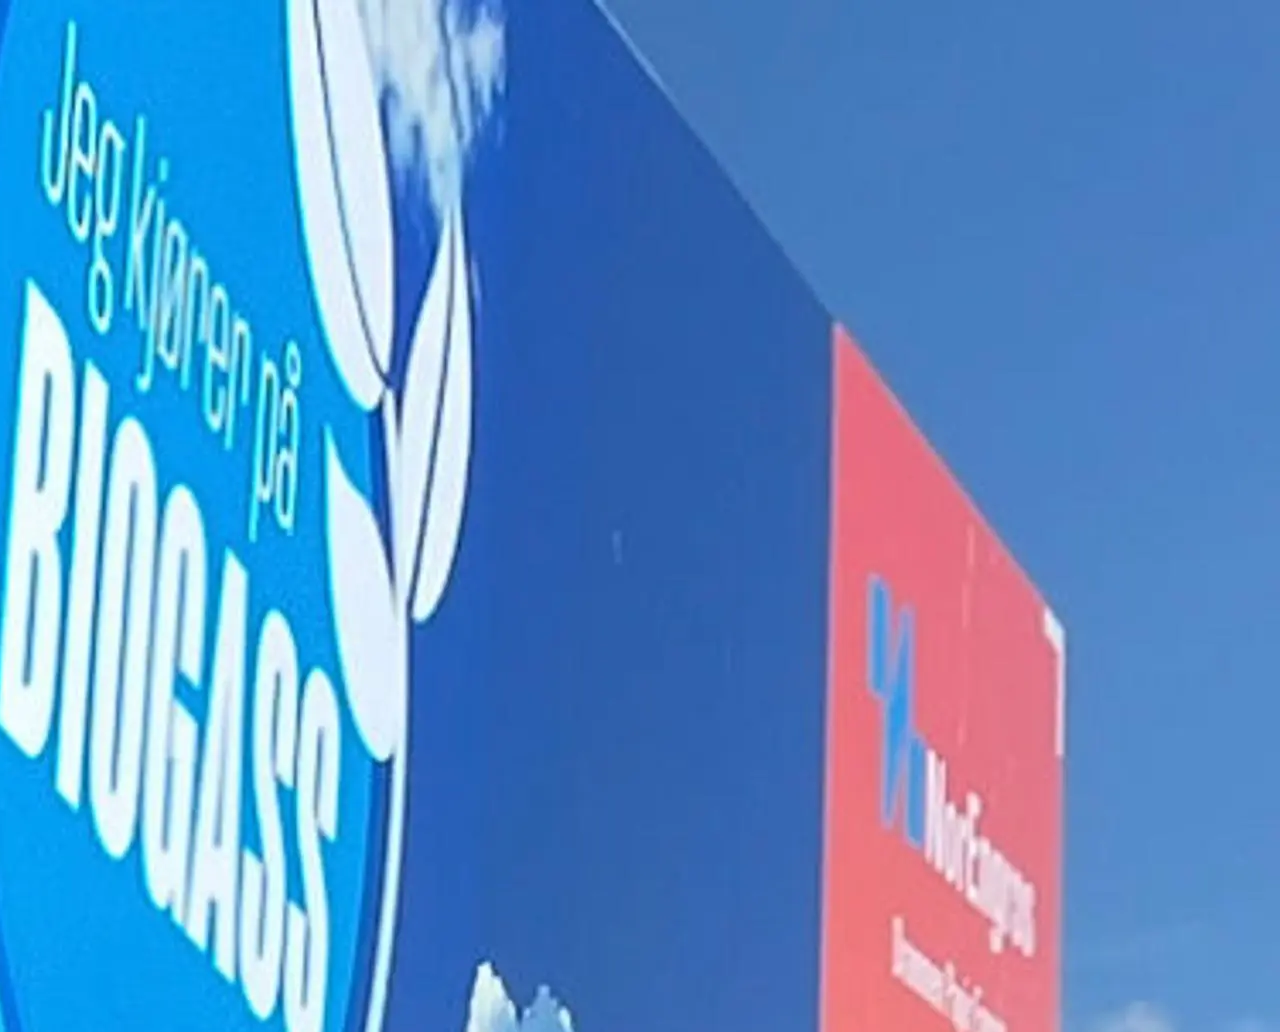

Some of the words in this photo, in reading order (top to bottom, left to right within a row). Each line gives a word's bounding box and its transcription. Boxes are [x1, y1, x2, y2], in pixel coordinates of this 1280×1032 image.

[43, 20, 125, 334] Jeg
[125, 116, 252, 449] kjører
[249, 341, 301, 541] på
